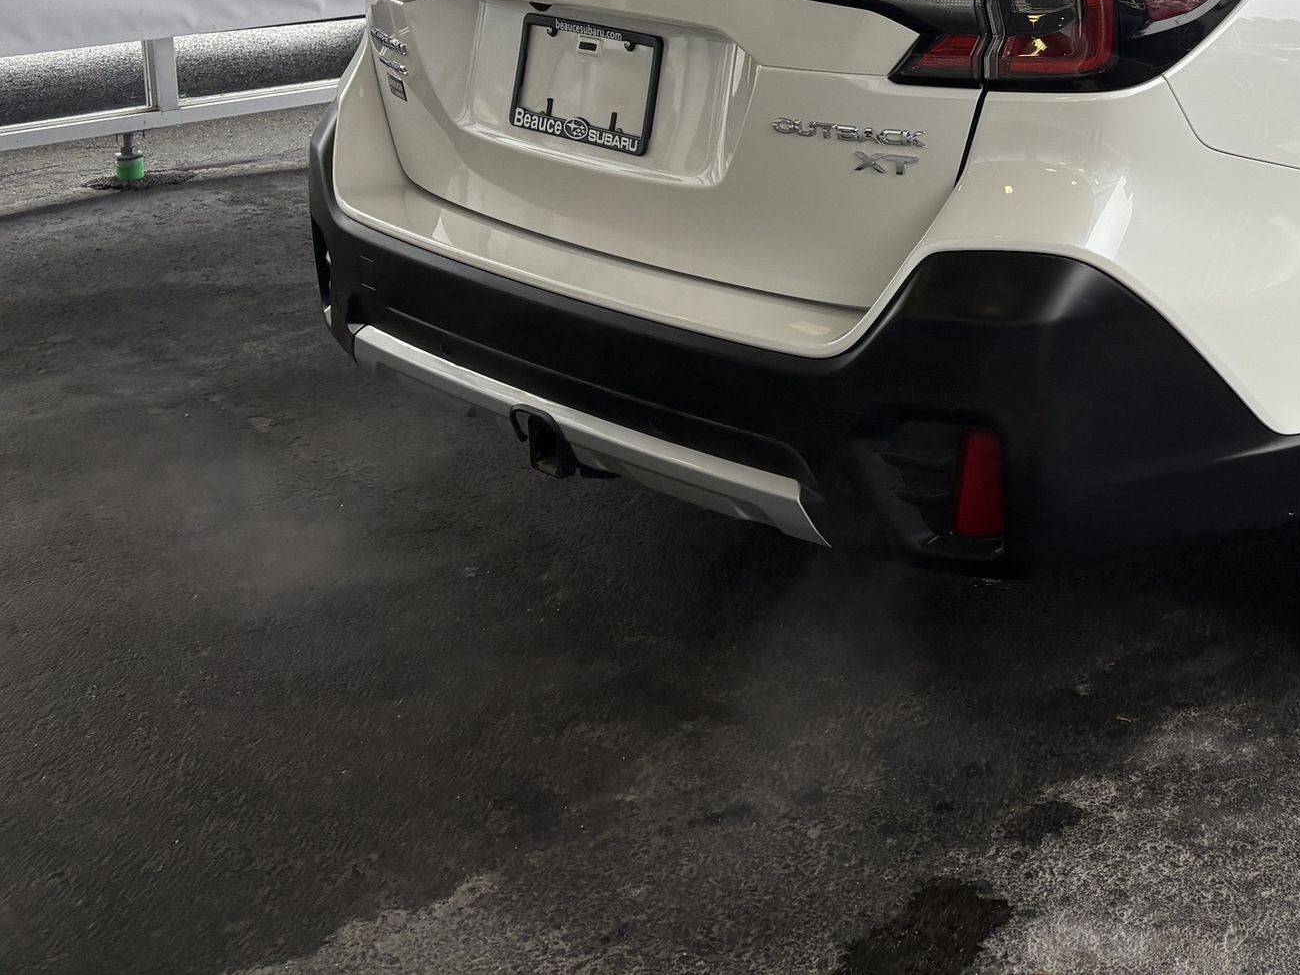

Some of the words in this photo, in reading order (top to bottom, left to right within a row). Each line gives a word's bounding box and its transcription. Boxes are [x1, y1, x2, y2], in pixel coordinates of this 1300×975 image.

[555, 18, 623, 41] beaucesubaru.com
[513, 107, 562, 135] Beauce
[587, 129, 638, 152] SUBARU
[772, 117, 927, 148] OUTBACK
[854, 151, 919, 175] XT
